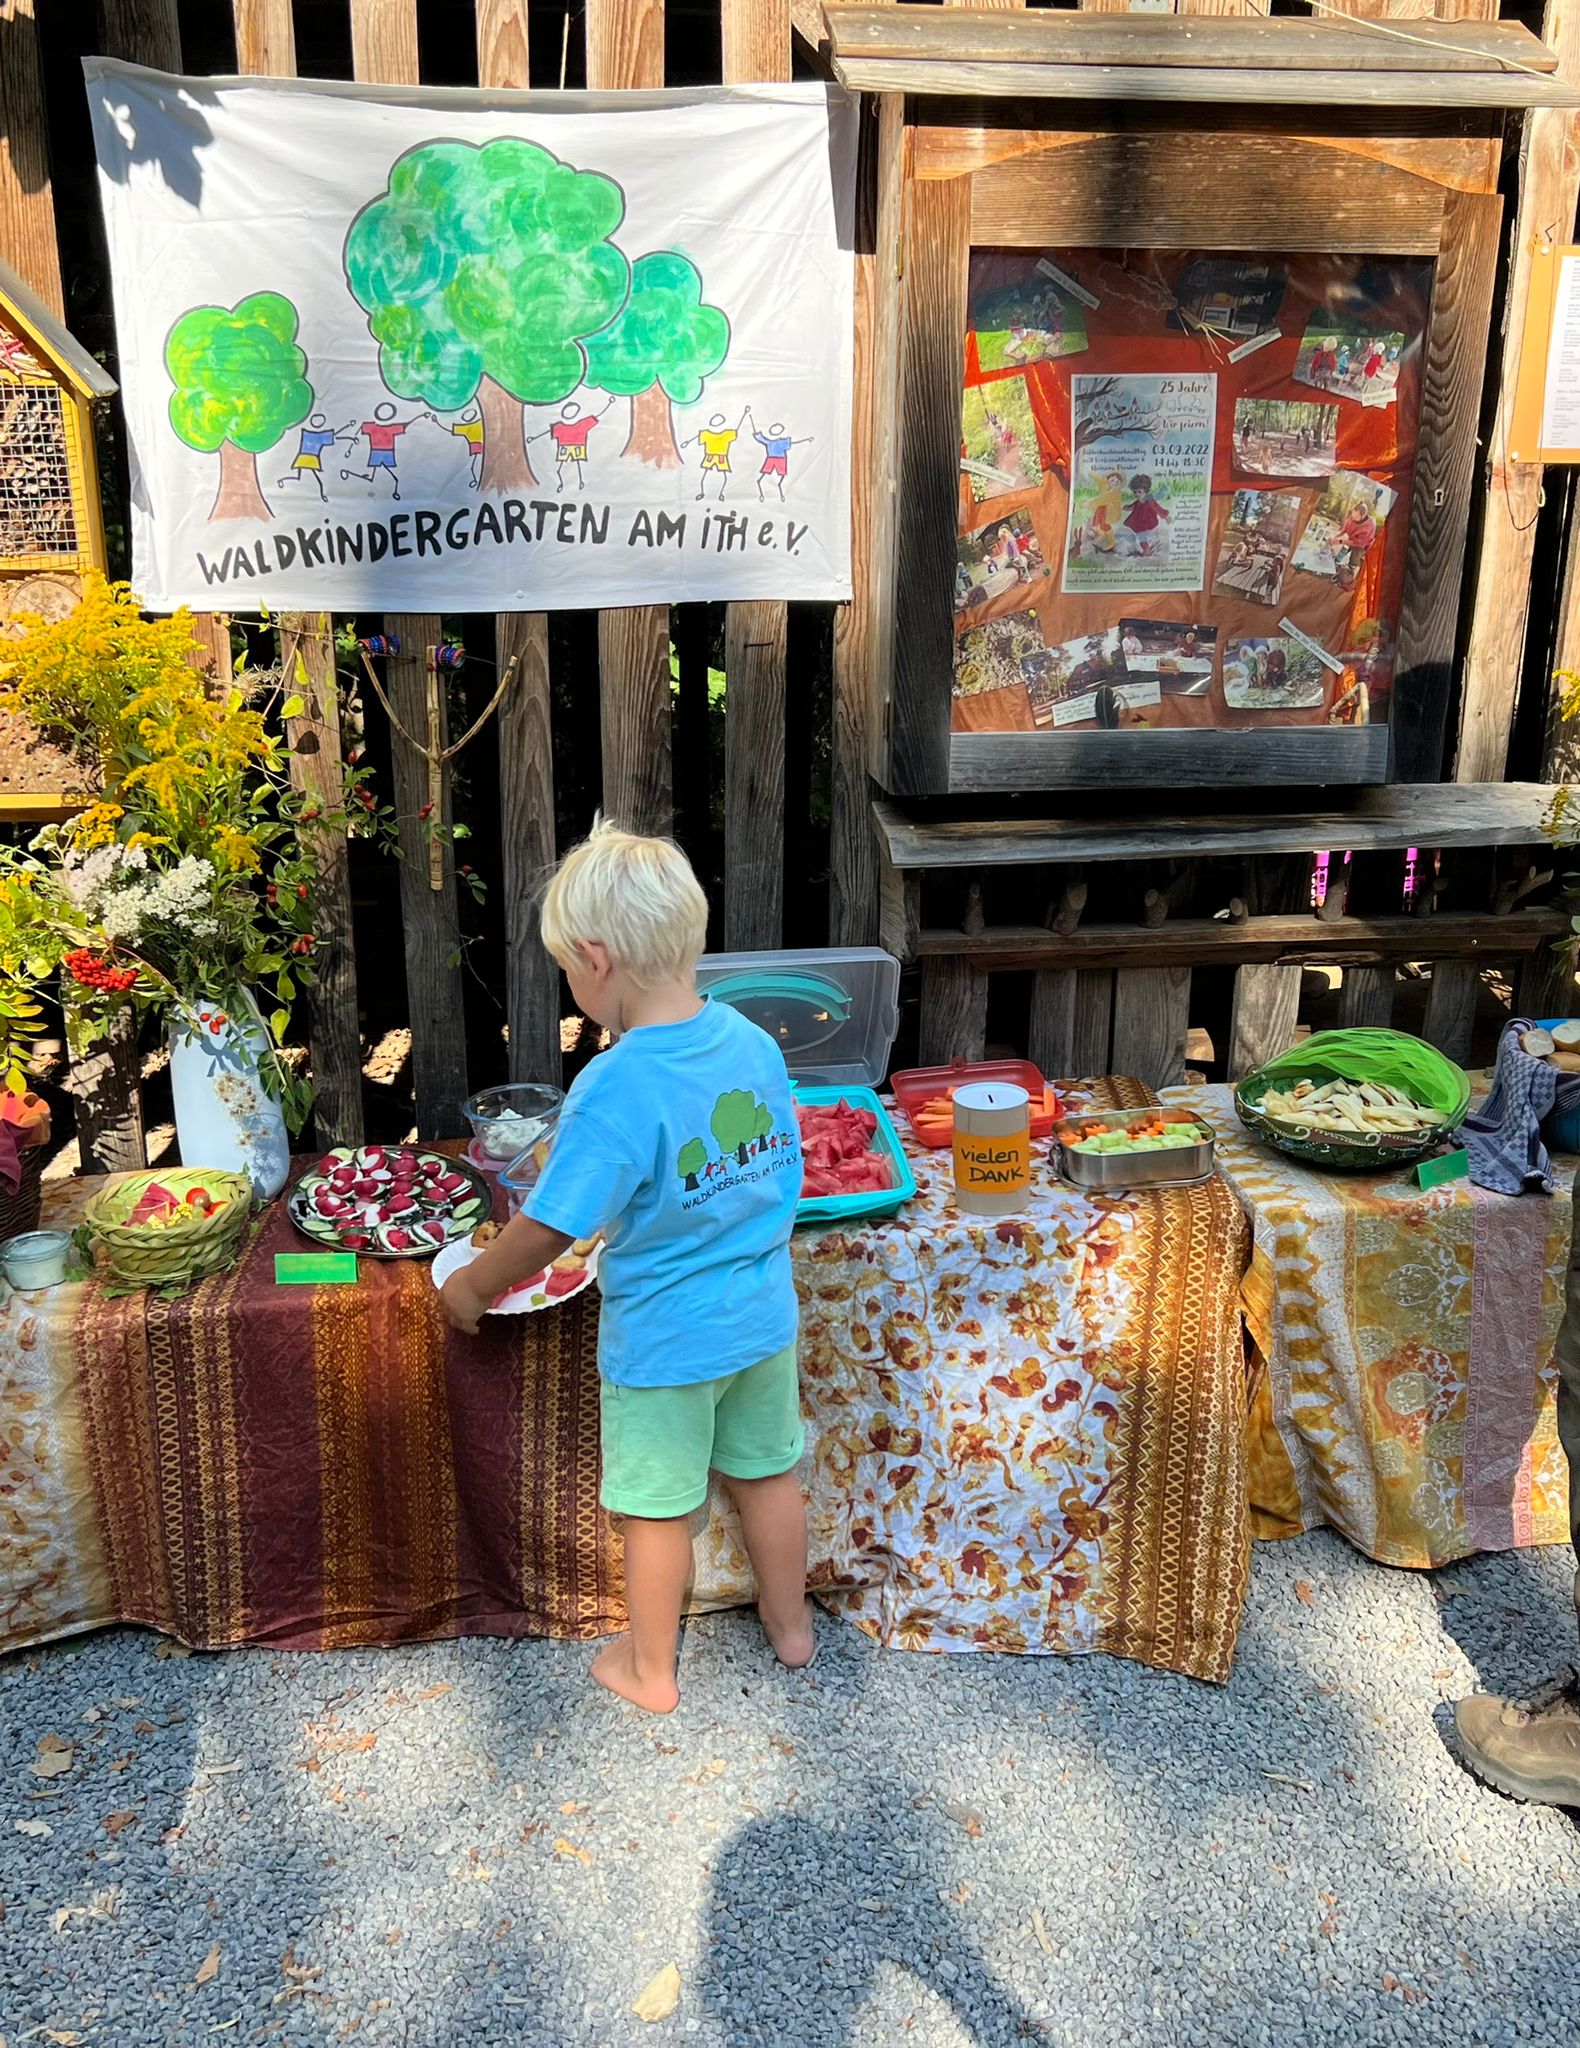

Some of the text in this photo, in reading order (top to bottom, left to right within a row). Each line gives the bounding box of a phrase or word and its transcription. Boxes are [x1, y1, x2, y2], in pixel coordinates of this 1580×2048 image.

[1160, 380, 1209, 394] 25 Jahre
[1152, 444, 1209, 456] 03.09.2022
[627, 508, 688, 549] AM
[757, 518, 809, 556] e.V.
[960, 1144, 1019, 1164] vielen
[968, 1165, 1025, 1183] DANK
